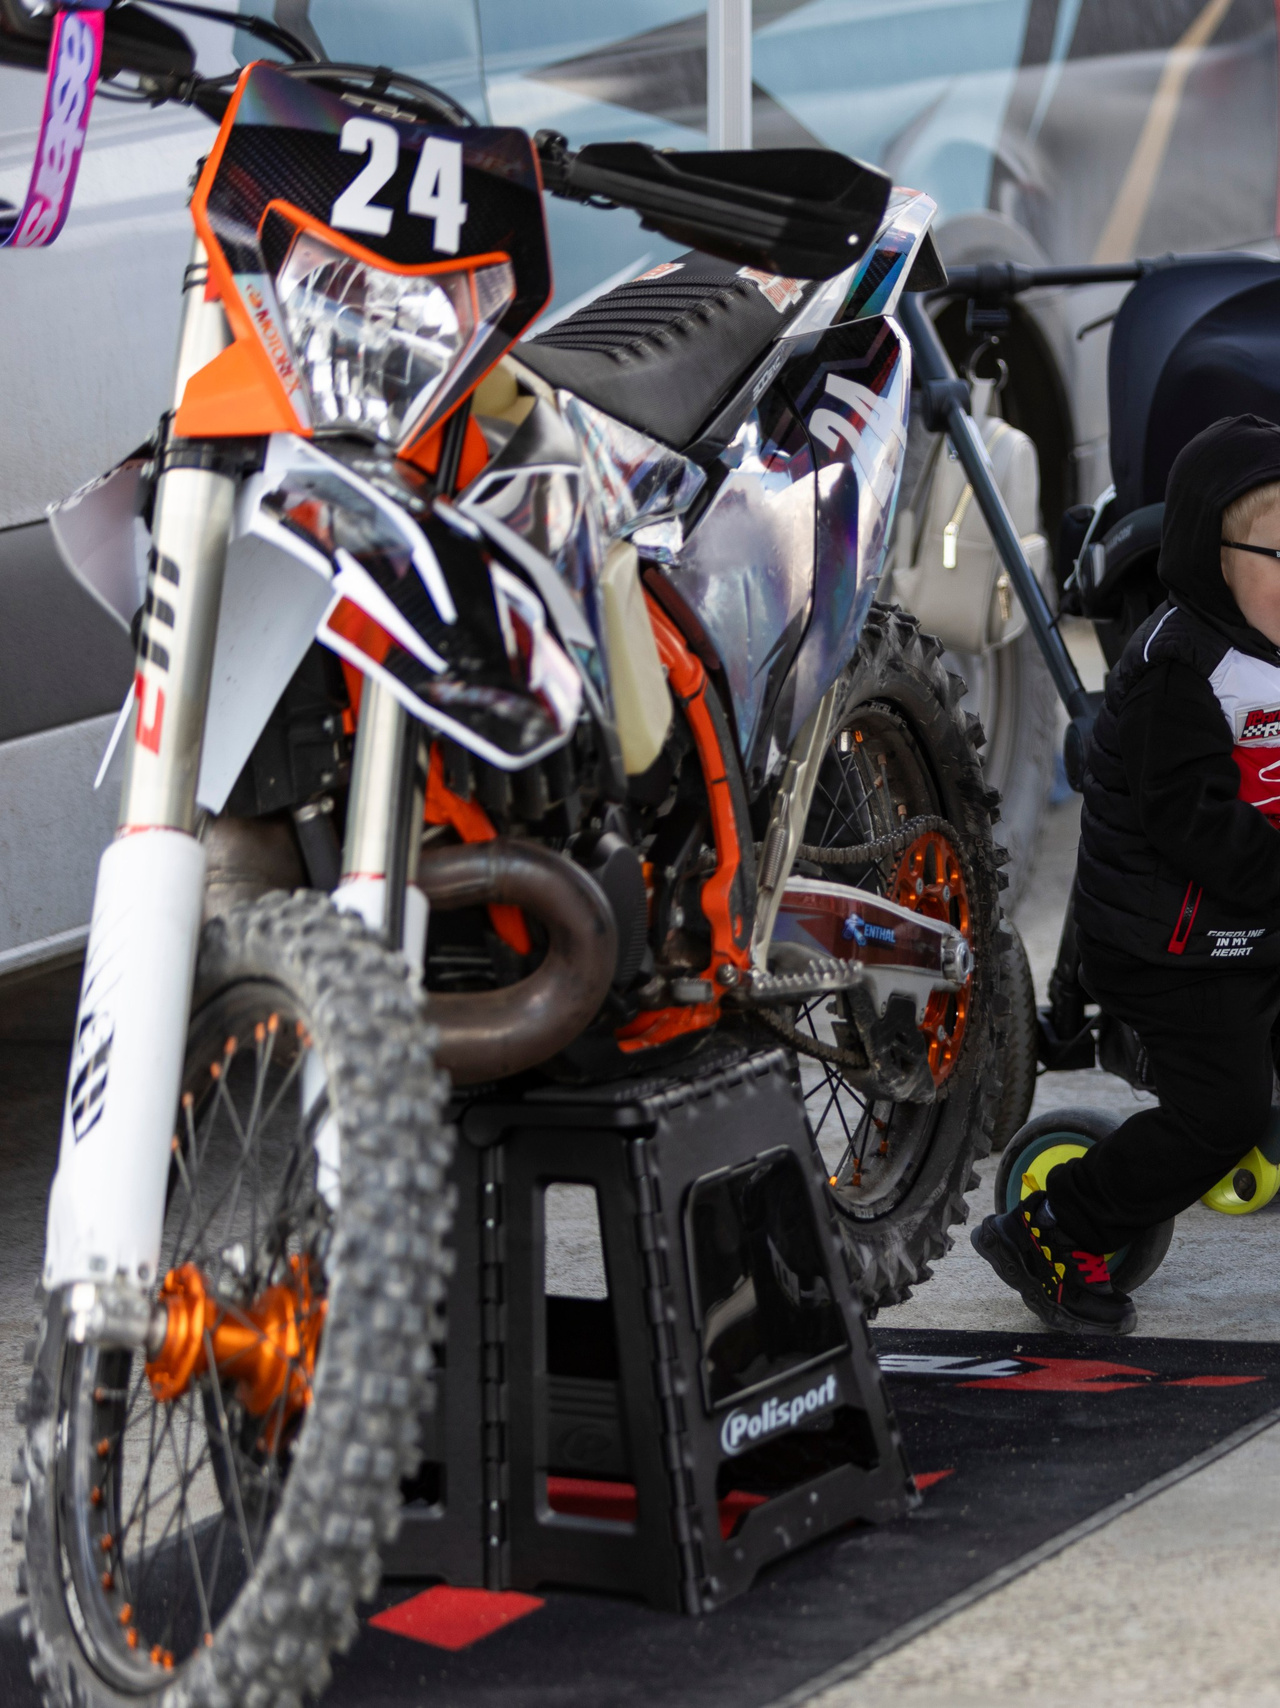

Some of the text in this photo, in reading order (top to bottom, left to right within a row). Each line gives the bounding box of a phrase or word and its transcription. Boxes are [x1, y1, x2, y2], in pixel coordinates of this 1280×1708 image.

[331, 116, 468, 255] 24
[254, 307, 302, 396] MOTOREX
[1206, 928, 1266, 938] GASOLINE
[1210, 946, 1254, 957] HEART
[1215, 937, 1248, 947] IN MY
[728, 1373, 837, 1448] Polisport
